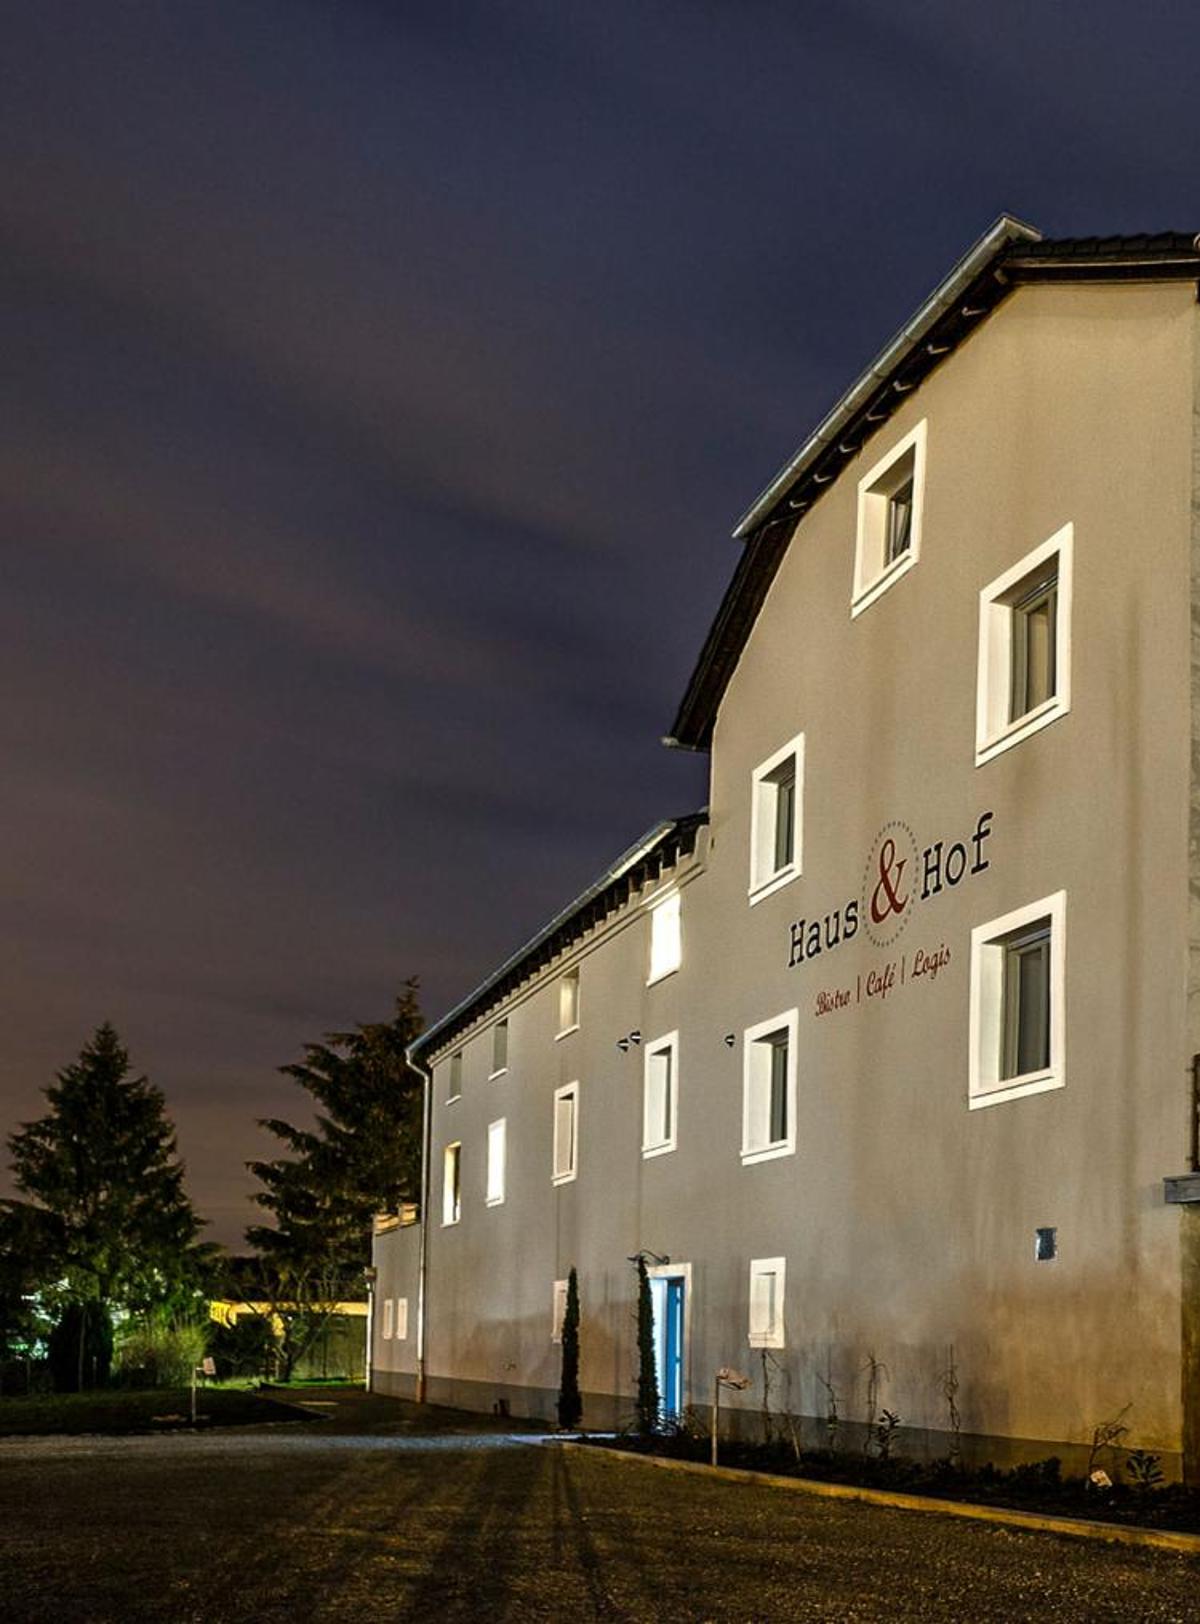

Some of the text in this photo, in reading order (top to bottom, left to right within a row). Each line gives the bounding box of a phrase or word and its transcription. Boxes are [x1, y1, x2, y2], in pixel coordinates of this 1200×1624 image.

[788, 812, 993, 967] Haus & Hof
[815, 990, 850, 1016] Bistro
[866, 963, 896, 998] Café
[912, 944, 951, 980] Logis
